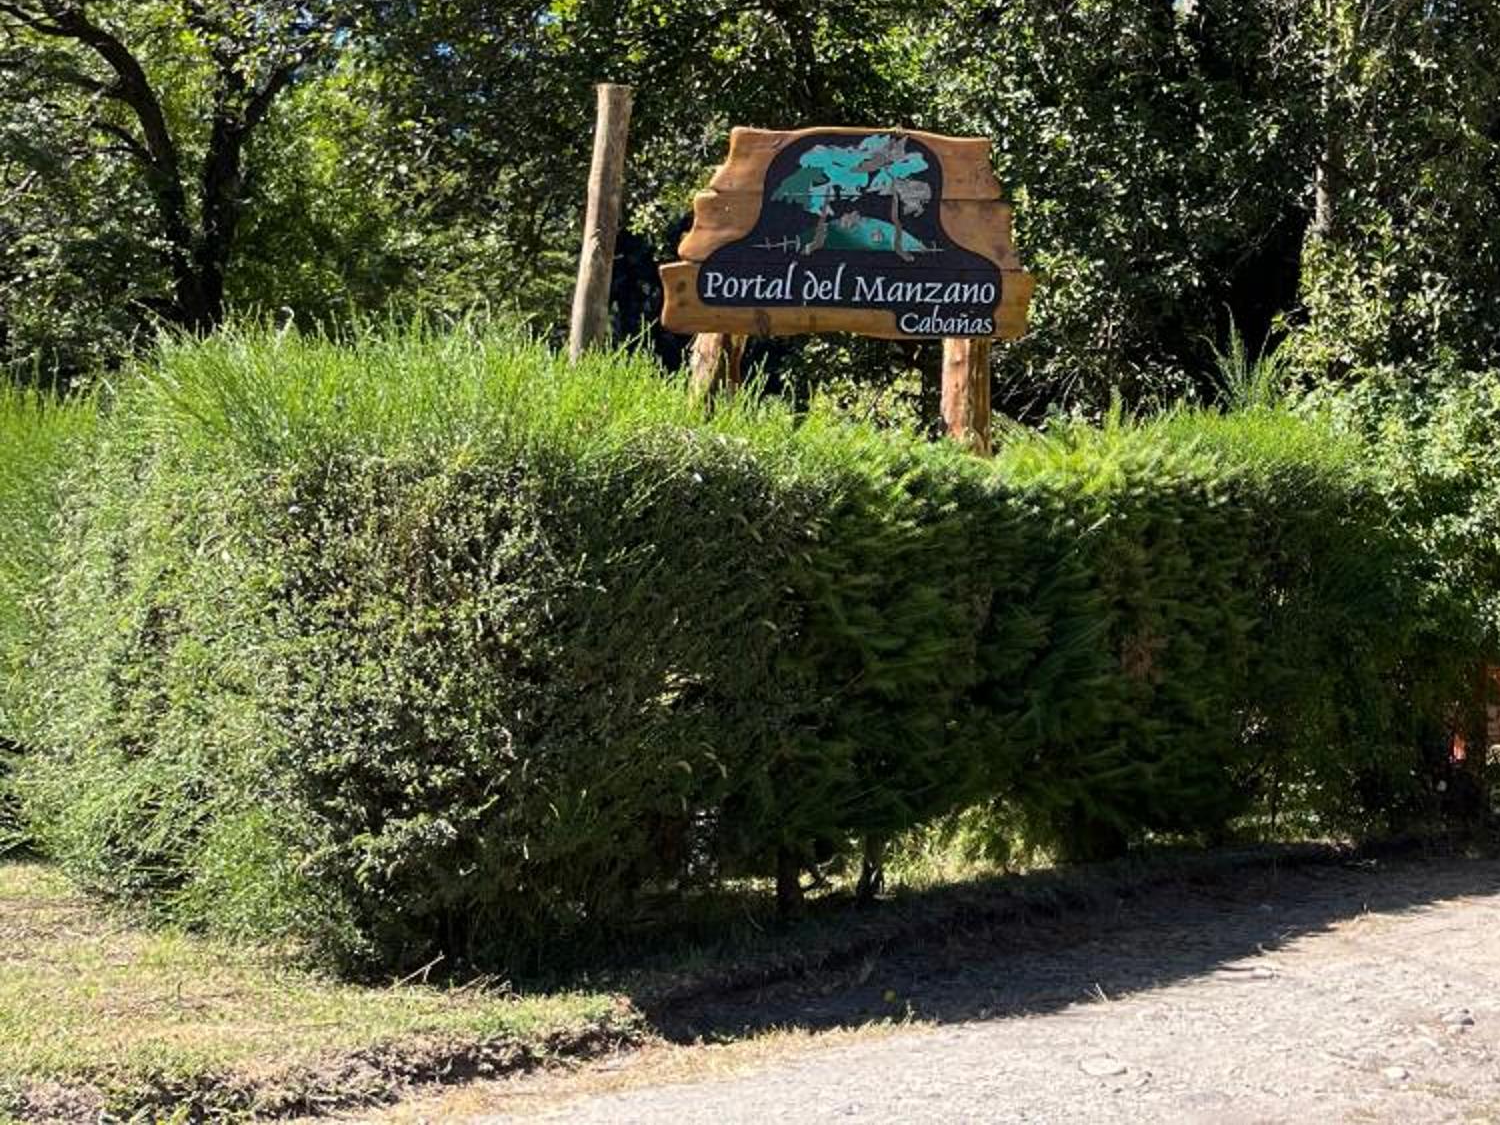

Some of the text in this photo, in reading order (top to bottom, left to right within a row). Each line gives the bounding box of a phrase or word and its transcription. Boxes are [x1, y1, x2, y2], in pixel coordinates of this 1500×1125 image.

[704, 261, 996, 306] Portal del Manzano
[900, 306, 993, 335] Cabañas
